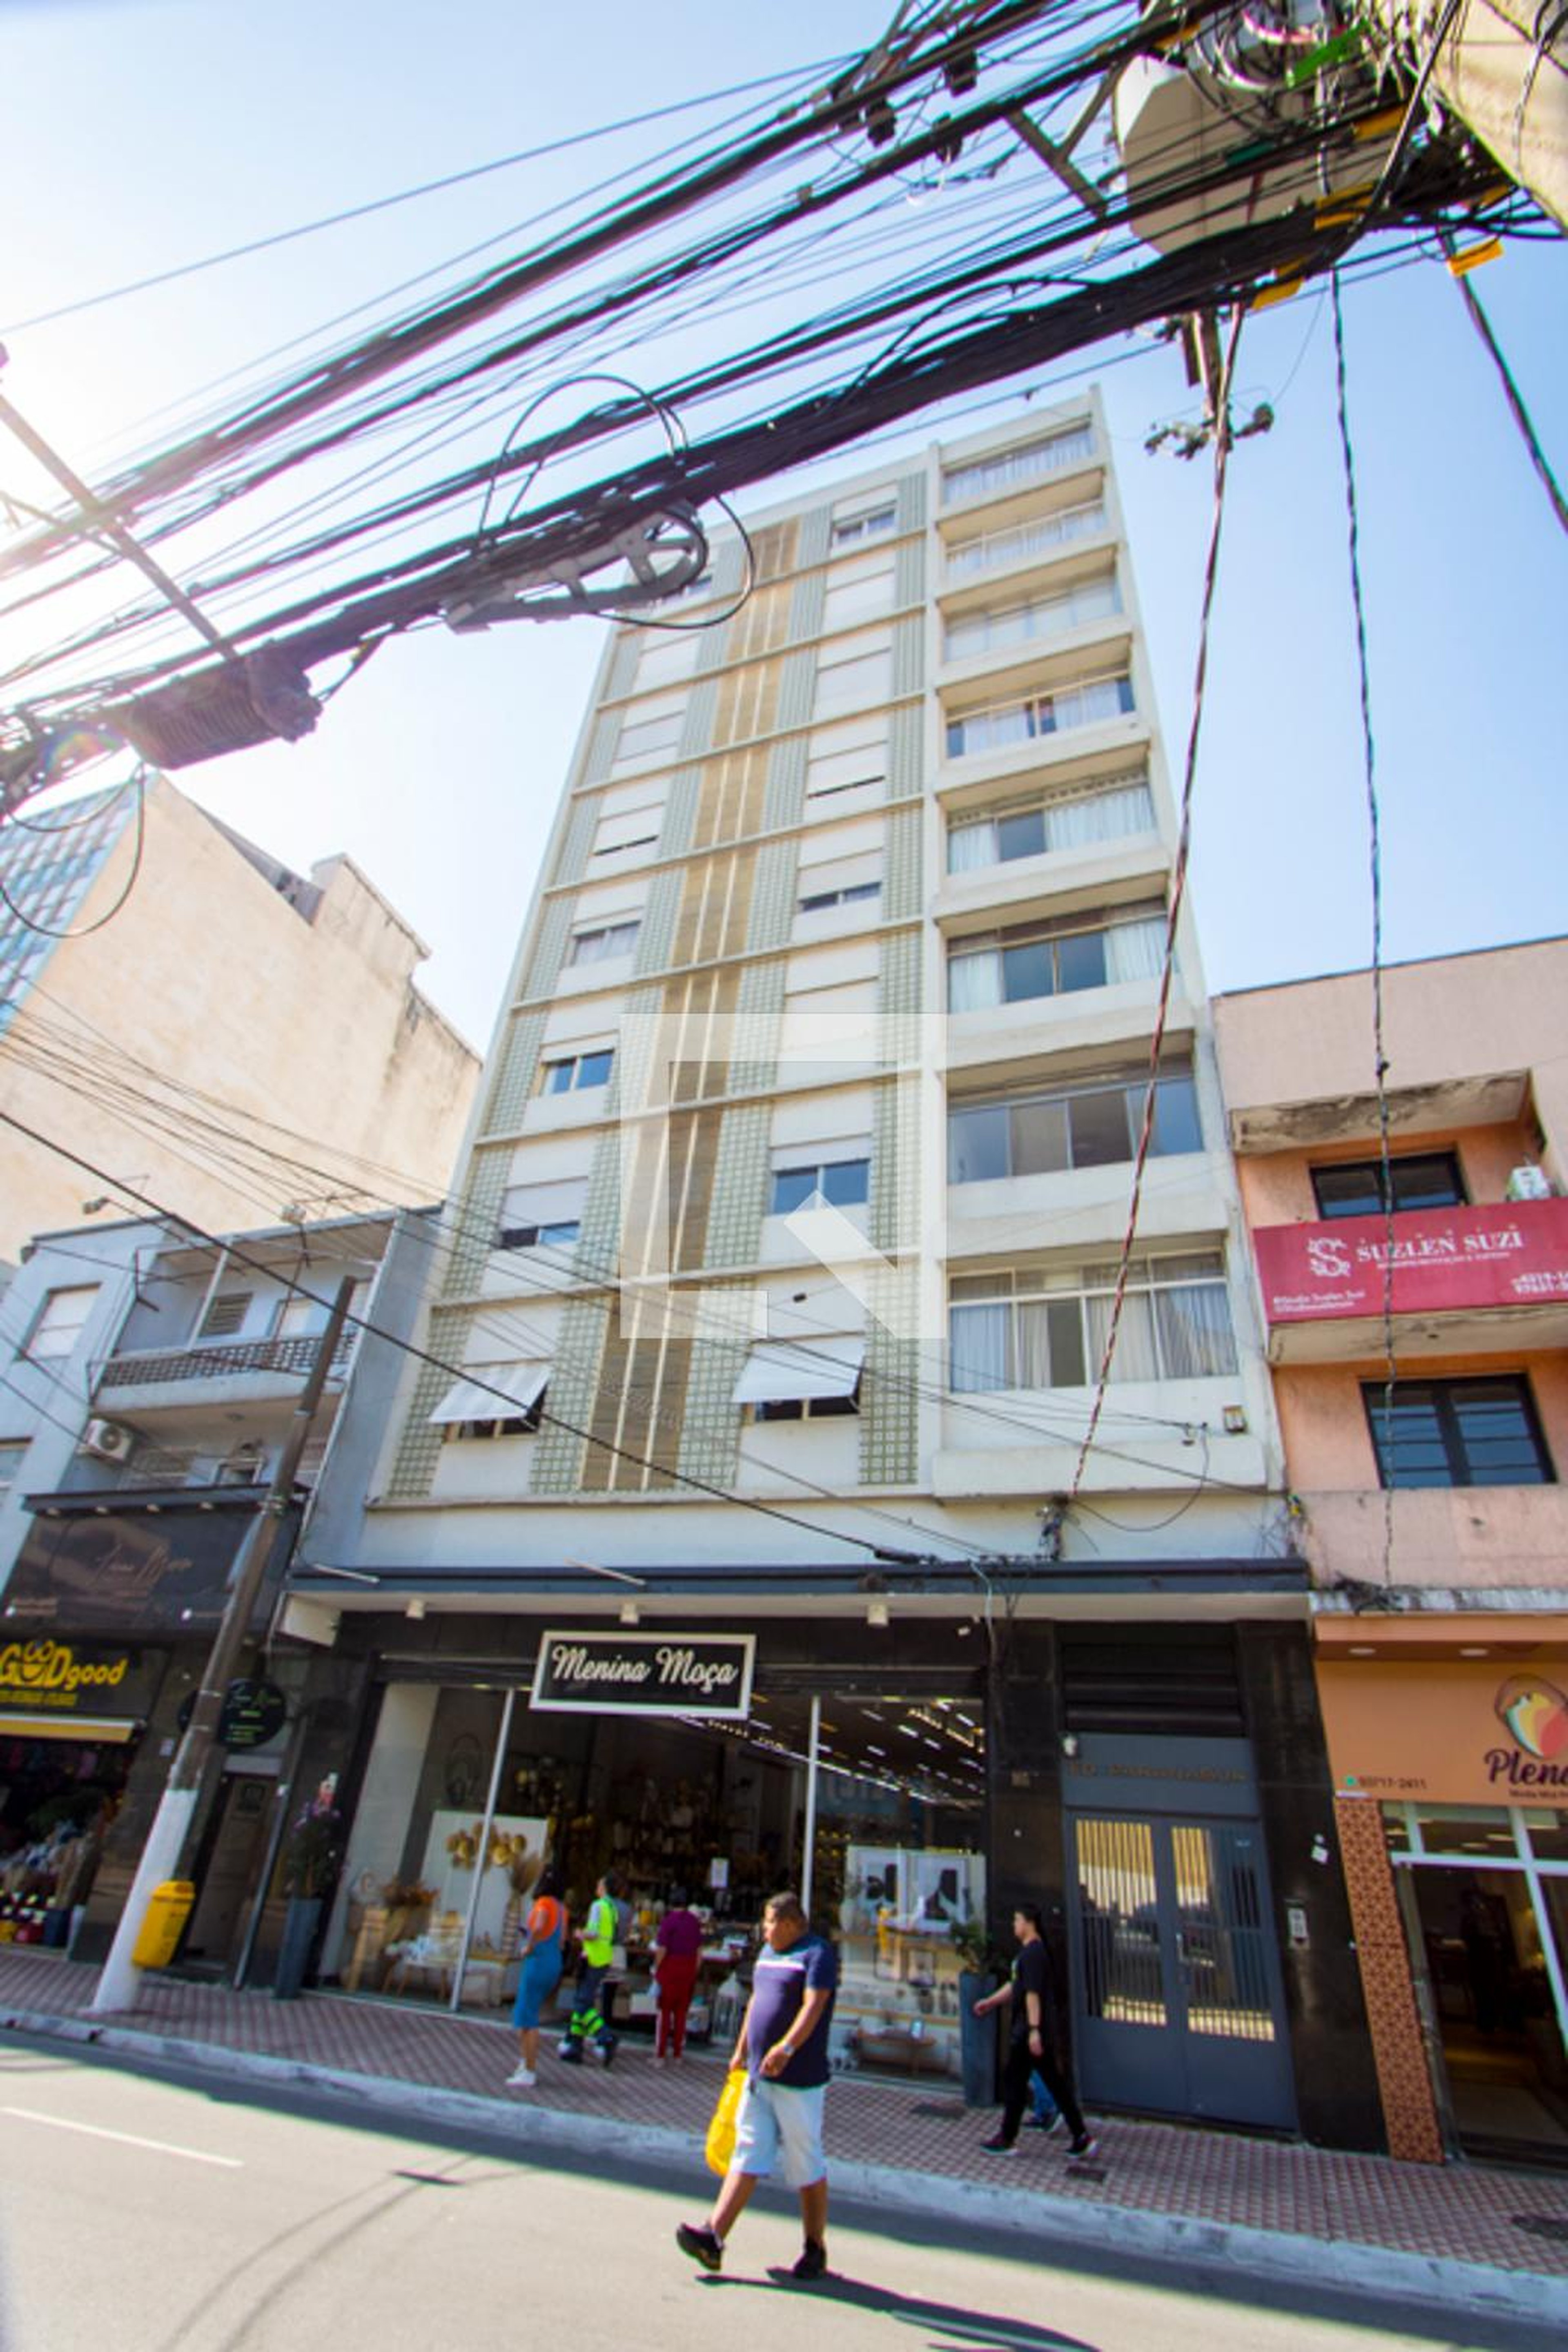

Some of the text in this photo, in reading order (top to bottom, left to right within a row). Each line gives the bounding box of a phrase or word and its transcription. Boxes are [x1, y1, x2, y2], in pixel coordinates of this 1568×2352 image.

[1463, 1228, 1523, 1252] SUZI
[552, 1645, 738, 1693] Menina Moça
